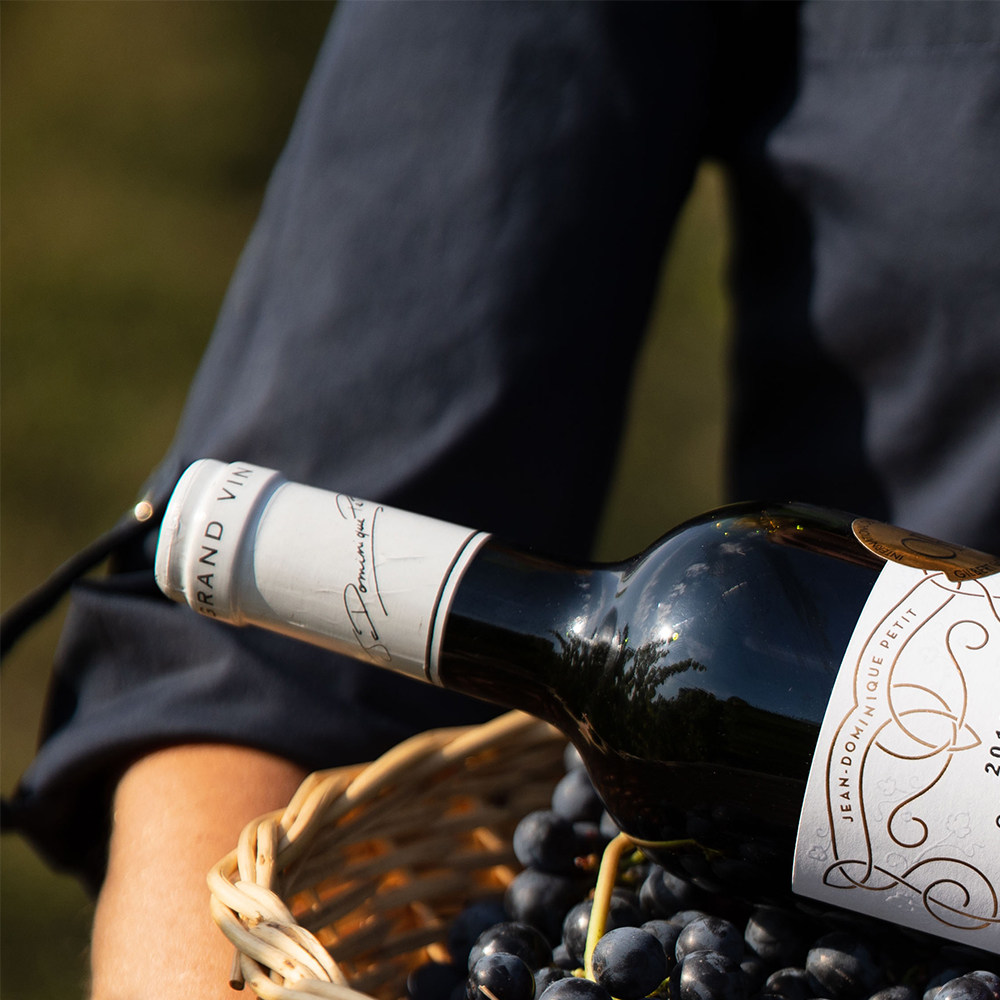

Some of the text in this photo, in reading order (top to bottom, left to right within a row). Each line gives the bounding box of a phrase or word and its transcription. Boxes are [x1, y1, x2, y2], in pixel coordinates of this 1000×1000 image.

[217, 467, 253, 501] VIN
[839, 608, 917, 823] JEAN-DOMINIQUE PETIT
